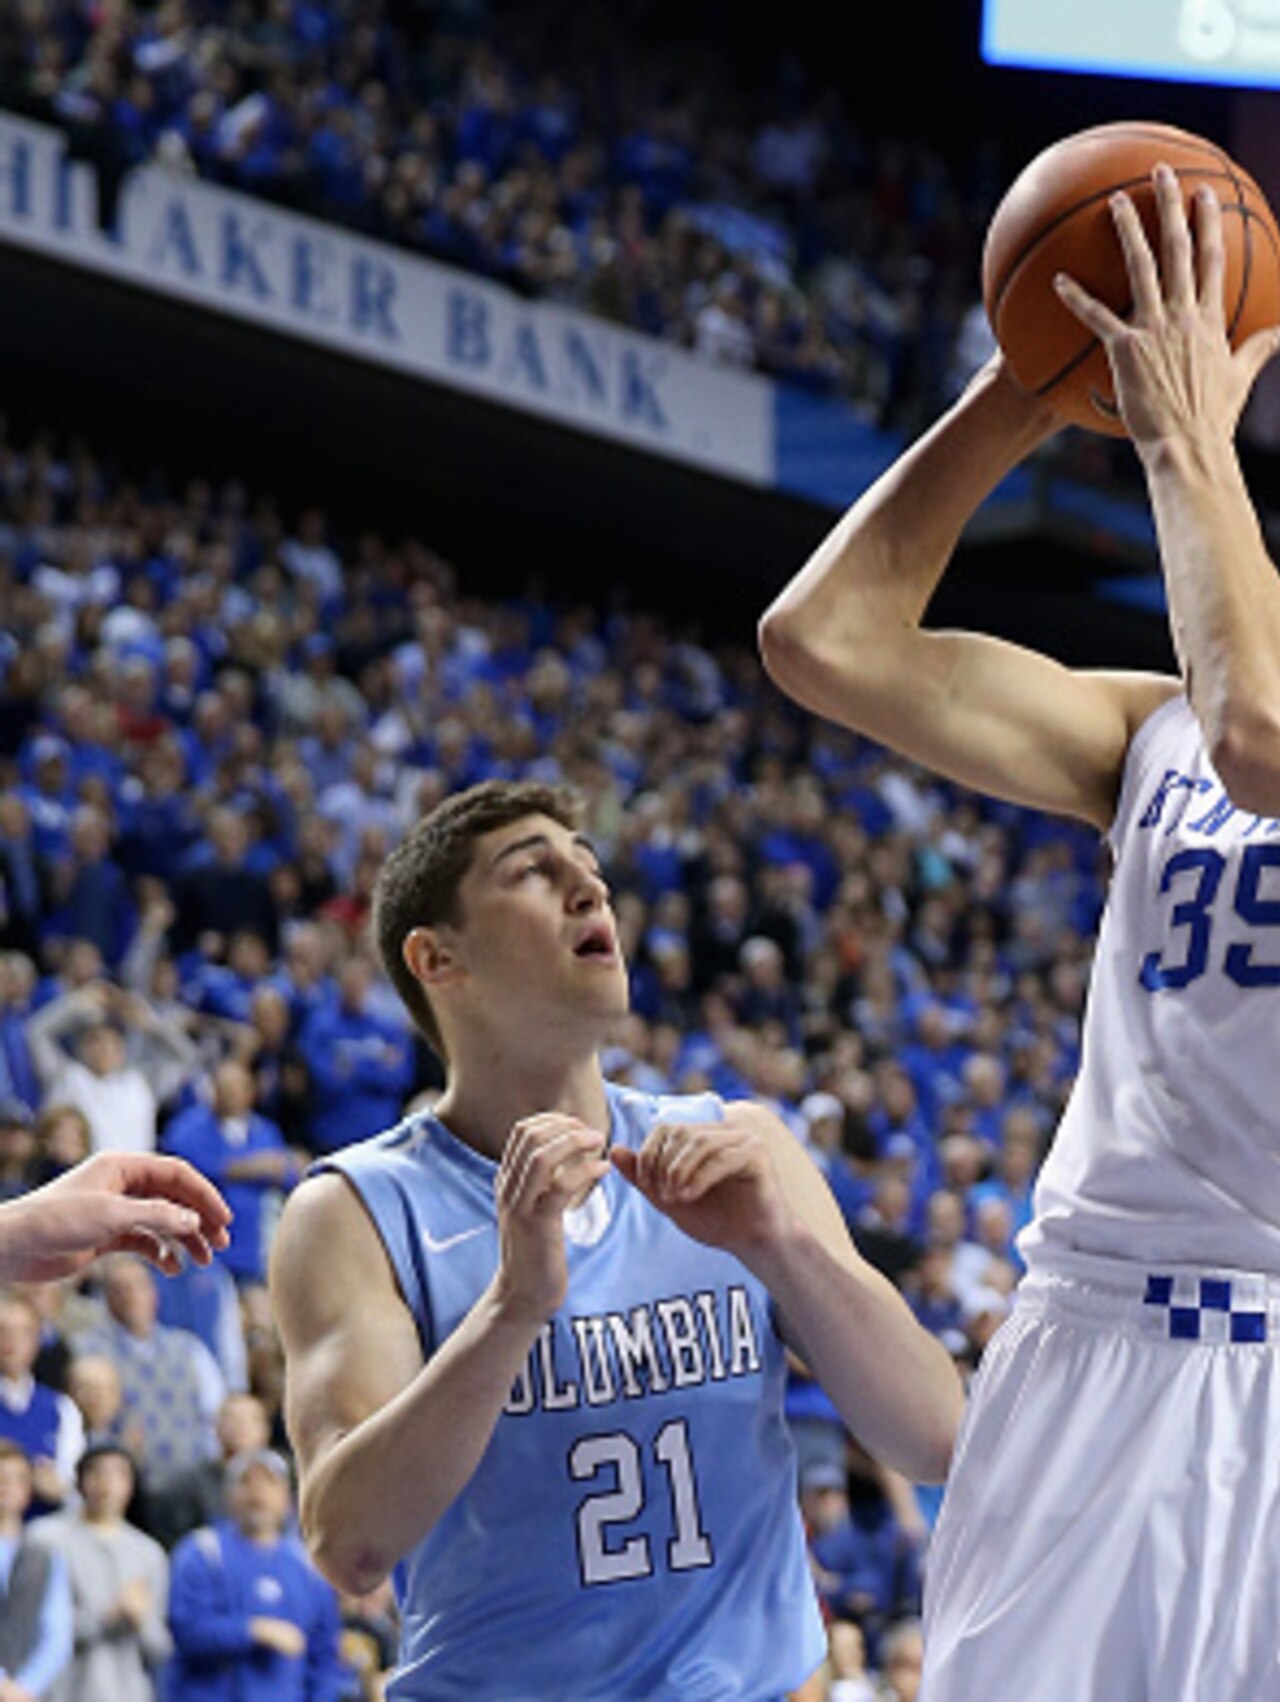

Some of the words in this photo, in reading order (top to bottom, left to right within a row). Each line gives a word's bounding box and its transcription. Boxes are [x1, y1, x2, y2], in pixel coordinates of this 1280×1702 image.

[446, 286, 670, 432] BANK
[503, 1286, 762, 1415] OLUMBIA
[568, 1416, 715, 1588] 21
